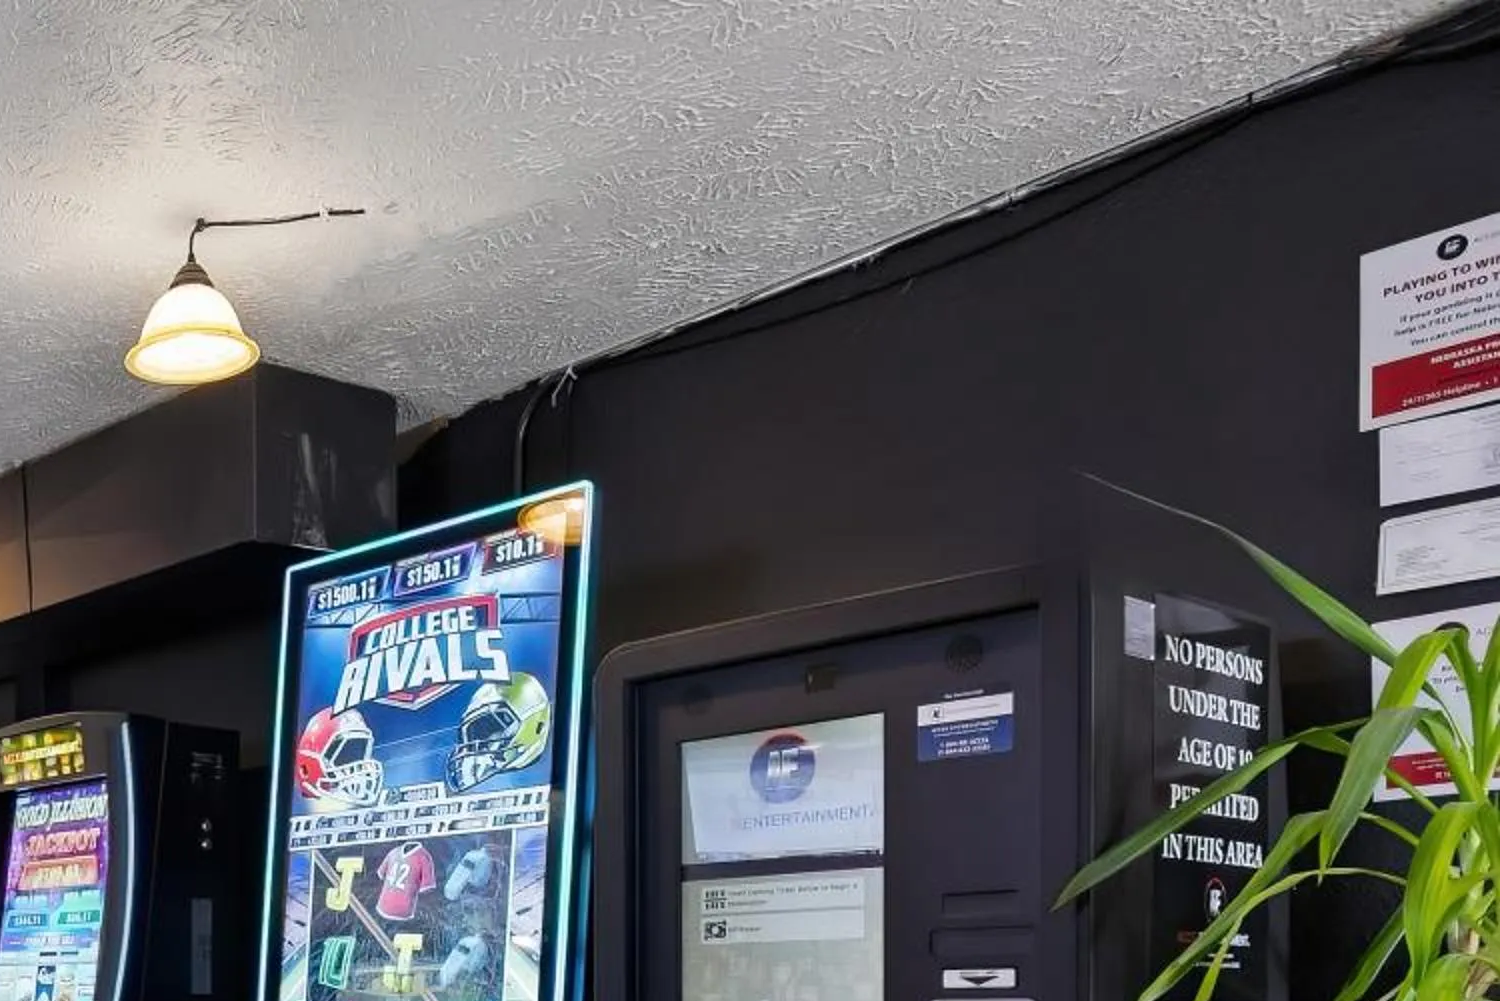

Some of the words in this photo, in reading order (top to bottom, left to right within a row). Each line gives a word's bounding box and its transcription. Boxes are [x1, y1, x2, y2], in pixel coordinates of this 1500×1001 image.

[1383, 270, 1447, 298] PLAYING
[1451, 263, 1471, 277] TO
[1415, 287, 1447, 303] YOU
[1451, 275, 1489, 293] INTO
[364, 606, 478, 655] COLLEGE
[332, 630, 512, 717] RIVALS
[1164, 633, 1193, 665] NO
[1195, 642, 1263, 685] PERSONS
[1167, 684, 1229, 723] UNDER
[1229, 699, 1261, 731] THE
[1177, 736, 1213, 767] AGE
[1214, 743, 1237, 771] OF
[1162, 833, 1183, 860] IN
[1184, 834, 1224, 865] THIS
[1224, 840, 1263, 869] AREA
